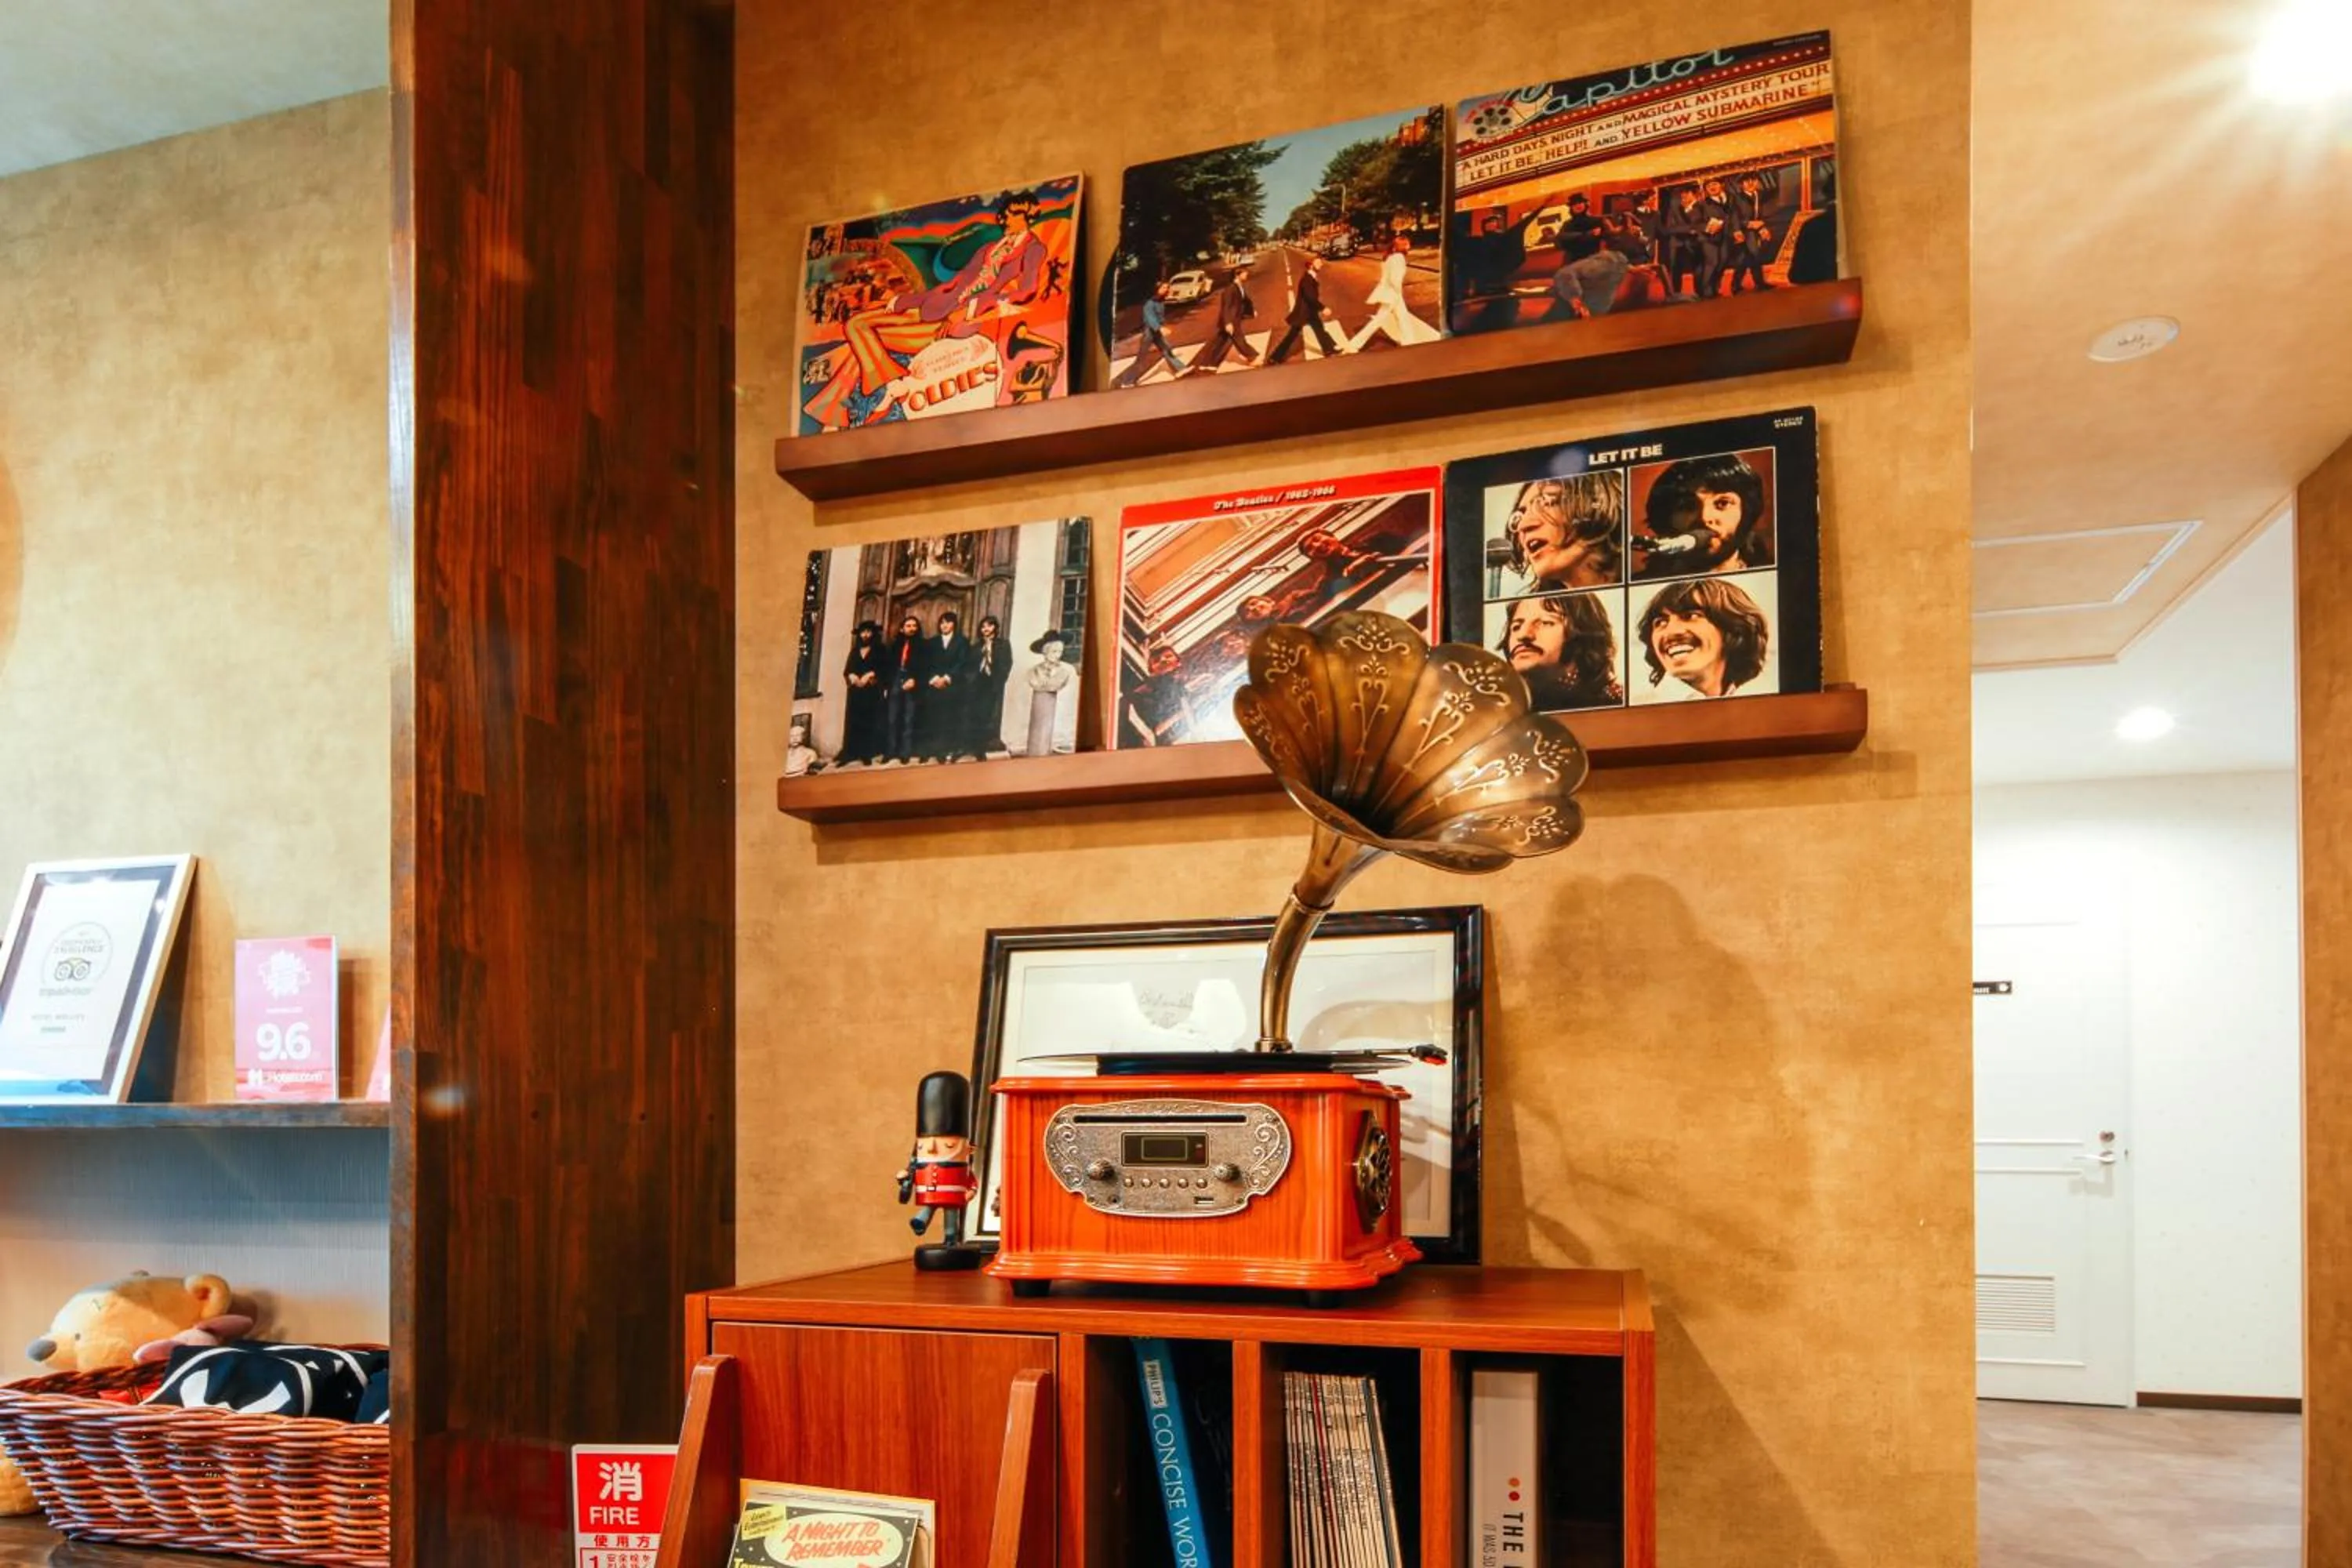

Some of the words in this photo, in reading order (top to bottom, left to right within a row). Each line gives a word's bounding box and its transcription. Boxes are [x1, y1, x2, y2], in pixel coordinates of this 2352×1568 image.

[1474, 149, 1509, 167] HARD
[1512, 138, 1548, 154] DAYS
[1551, 124, 1594, 144] NIGHT
[1597, 120, 1622, 131] AND
[1622, 100, 1691, 124] MAGICAL
[1695, 78, 1772, 105] MYSTERY
[1777, 64, 1830, 84] TOUR
[1470, 165, 1494, 181] LET
[1500, 161, 1511, 174] IT
[1545, 139, 1588, 161] HELP!
[1594, 136, 1619, 147] AND
[1621, 113, 1691, 139] YELLOW
[908, 361, 998, 412] OLDIES
[1588, 450, 1619, 466] LET
[1621, 446, 1639, 461] IT
[1640, 443, 1663, 457] BE
[1214, 499, 1236, 510] The
[1236, 495, 1275, 508] Beatles
[256, 1022, 312, 1062] 9.6
[1146, 1363, 1164, 1405] PHILIP'S
[598, 1461, 643, 1501] 消
[1152, 1413, 1188, 1510] CONCISE
[1173, 1516, 1199, 1568] WOR
[589, 1506, 641, 1526] FIRE
[781, 1523, 800, 1543] A
[800, 1521, 858, 1541] NIGHT
[858, 1520, 880, 1538] TO
[1503, 1512, 1524, 1553] THE
[785, 1539, 884, 1561] REMEMBER
